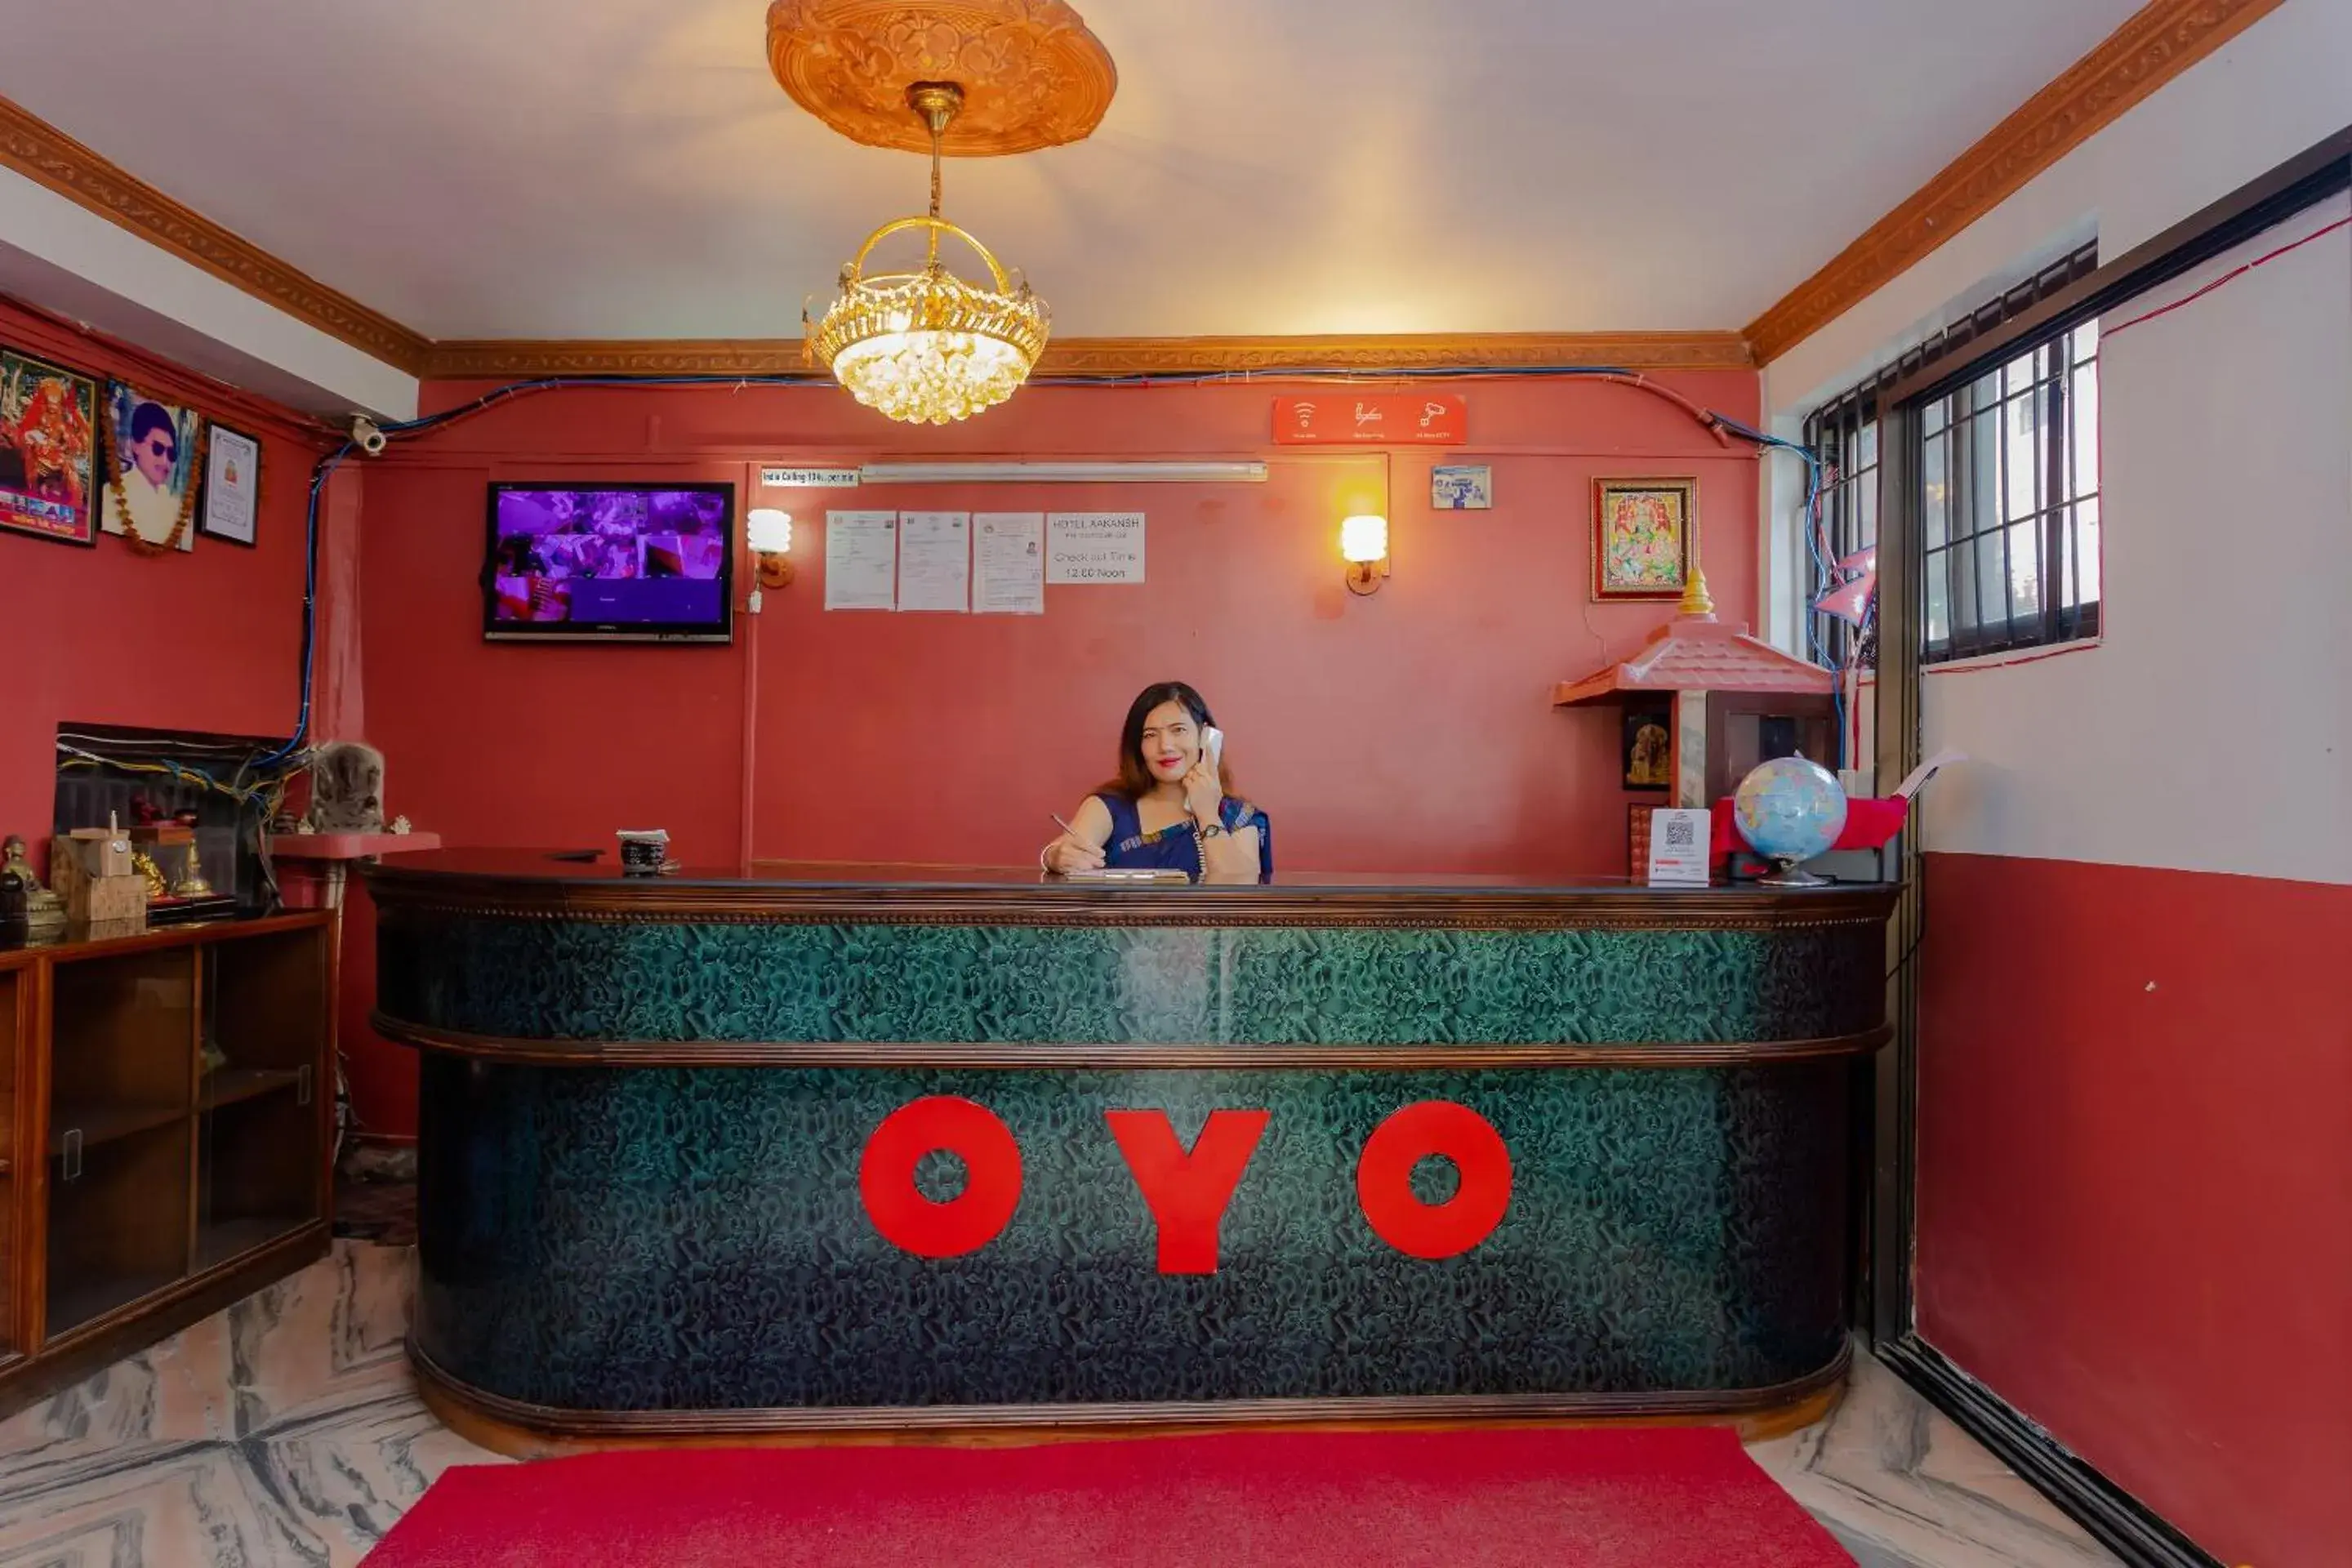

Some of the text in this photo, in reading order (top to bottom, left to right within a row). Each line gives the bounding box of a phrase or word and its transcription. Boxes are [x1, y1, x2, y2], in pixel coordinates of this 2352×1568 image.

[1054, 519, 1085, 529] HOTEL
[1097, 568, 1125, 578] Noon
[859, 1095, 1512, 1274] OYO
